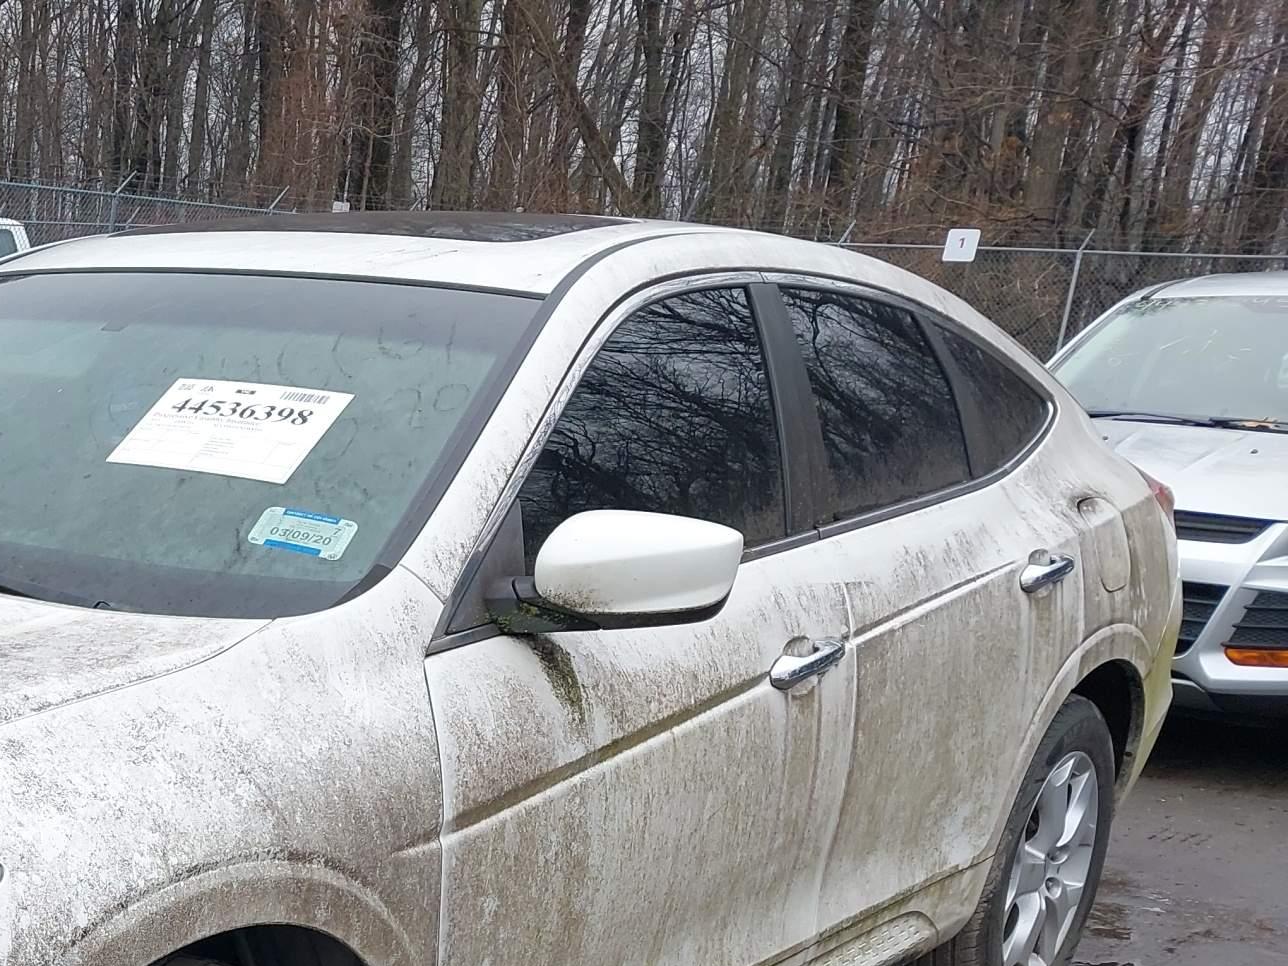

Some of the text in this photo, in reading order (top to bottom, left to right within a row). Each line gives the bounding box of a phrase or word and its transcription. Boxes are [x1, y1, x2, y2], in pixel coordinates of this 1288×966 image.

[959, 237, 966, 249] 1
[172, 398, 314, 426] 44536398
[270, 526, 332, 546] 03/09/20
